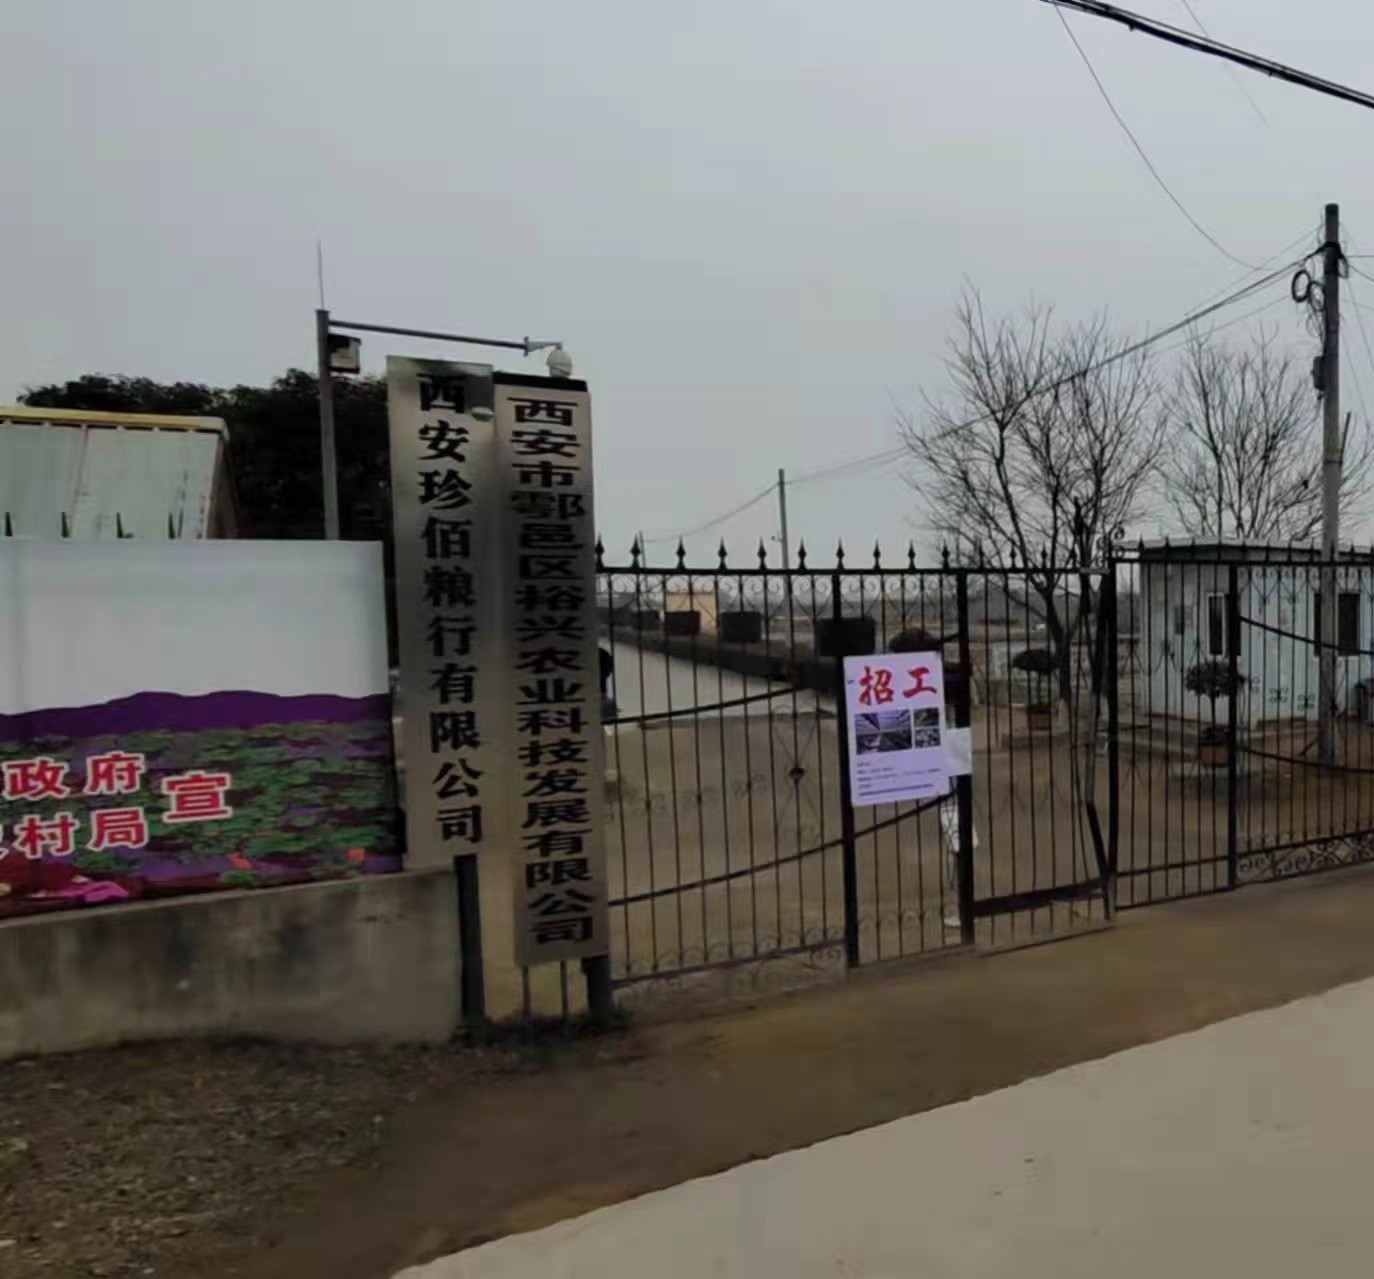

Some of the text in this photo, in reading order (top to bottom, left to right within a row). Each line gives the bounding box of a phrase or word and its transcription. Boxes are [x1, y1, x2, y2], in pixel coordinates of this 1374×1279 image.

[416, 373, 483, 843] 西安珍佰粮行有限公司
[508, 397, 594, 944] 西安市鄠邑区裕兴农业科技发展有限公司
[858, 665, 938, 706] 招工
[163, 771, 233, 823] 宣
[0, 808, 149, 859] 村局
